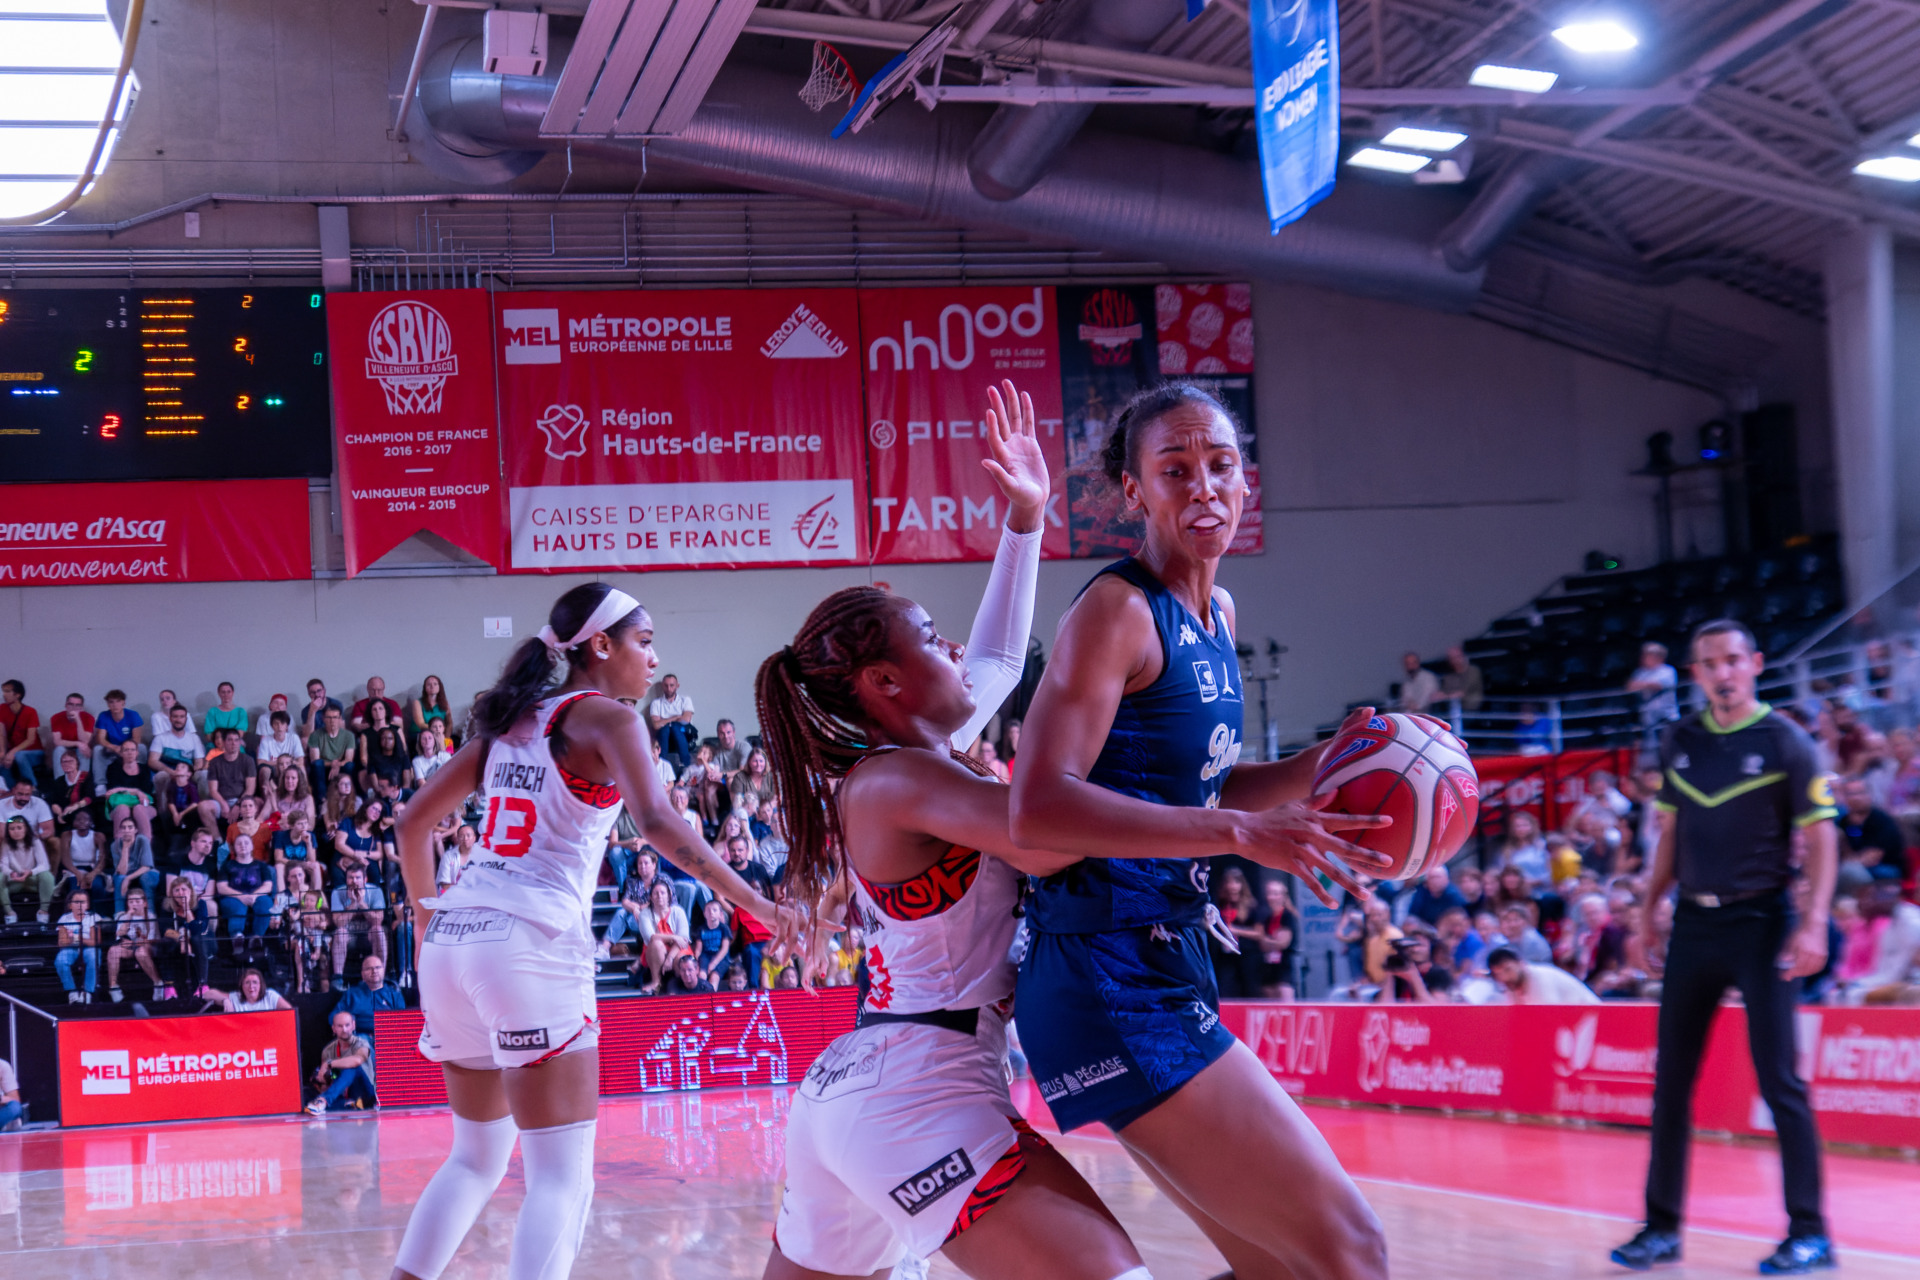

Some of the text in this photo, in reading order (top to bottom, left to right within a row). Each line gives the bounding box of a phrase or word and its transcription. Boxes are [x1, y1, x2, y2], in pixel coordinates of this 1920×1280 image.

[241, 295, 253, 308] 2
[310, 294, 321, 308] 0
[119, 308, 127, 316] 2
[106, 320, 128, 328] S 3
[568, 313, 732, 338] MÉTROPOLE
[760, 303, 849, 358] LEROY MERLIN
[235, 338, 247, 351] 2
[373, 305, 447, 364] ESBVA
[503, 327, 561, 346] MEL
[569, 338, 733, 353] EUROPÉENNE DE LILLE
[75, 351, 93, 371] 2
[246, 354, 255, 365] 4
[313, 352, 322, 365] 0
[371, 361, 453, 375] VILLENEUVE D'ASCQ
[237, 395, 249, 409] 2
[101, 415, 119, 438] 2
[601, 408, 673, 430] Région
[345, 428, 488, 444] CHAMPION DE FRANCE
[603, 431, 822, 456] Hauts-de-France
[384, 446, 412, 457] 2016
[424, 444, 452, 455] 2017
[351, 484, 490, 500] VAINQUEUR EUROCUP
[387, 502, 416, 512] 2014
[428, 499, 457, 510] 2015
[531, 503, 771, 527] CAISSE D'EPARGNE
[873, 494, 1063, 532] TARMK
[86, 517, 166, 542] d'Ascq
[533, 529, 771, 553] HAUTS DE FRANCE
[22, 556, 168, 579] mouvement
[491, 762, 546, 793] HIRSCH
[481, 796, 538, 857] 13
[498, 1029, 546, 1047] Nord
[137, 1047, 278, 1074] MÉTROPOLE
[1820, 1022, 1920, 1083] MÉTRO
[81, 1064, 131, 1080] MEL
[138, 1066, 279, 1086] EUROPÉENNE DE LILLE
[894, 1152, 967, 1209] Nord
